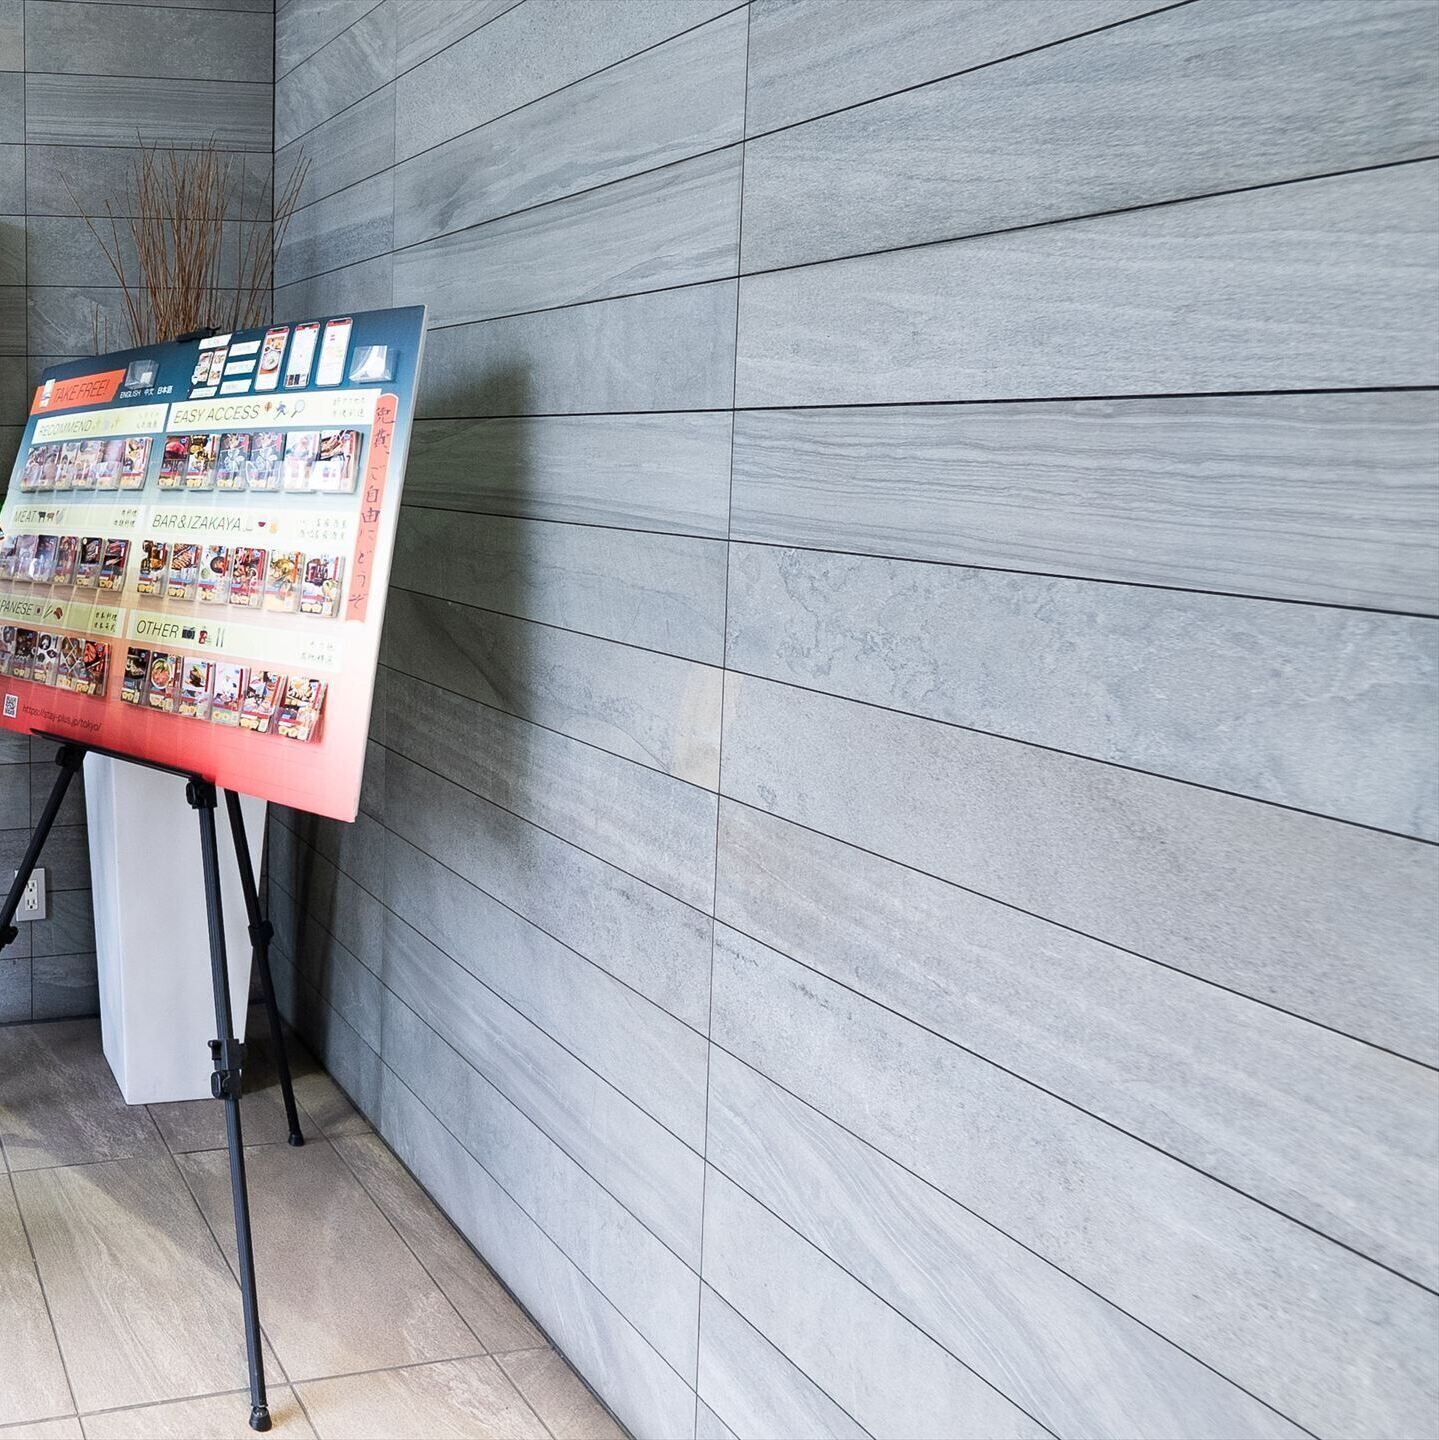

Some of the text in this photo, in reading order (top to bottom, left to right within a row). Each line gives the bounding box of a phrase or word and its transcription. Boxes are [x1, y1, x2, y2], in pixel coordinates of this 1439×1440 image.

[120, 390, 141, 399] ENGLISH
[173, 409, 205, 424] EASY
[206, 404, 260, 421] ACCESS
[14, 509, 38, 523] MEAT
[152, 513, 241, 532] BAR&IZAKAYA
[136, 619, 180, 639] OTHER
